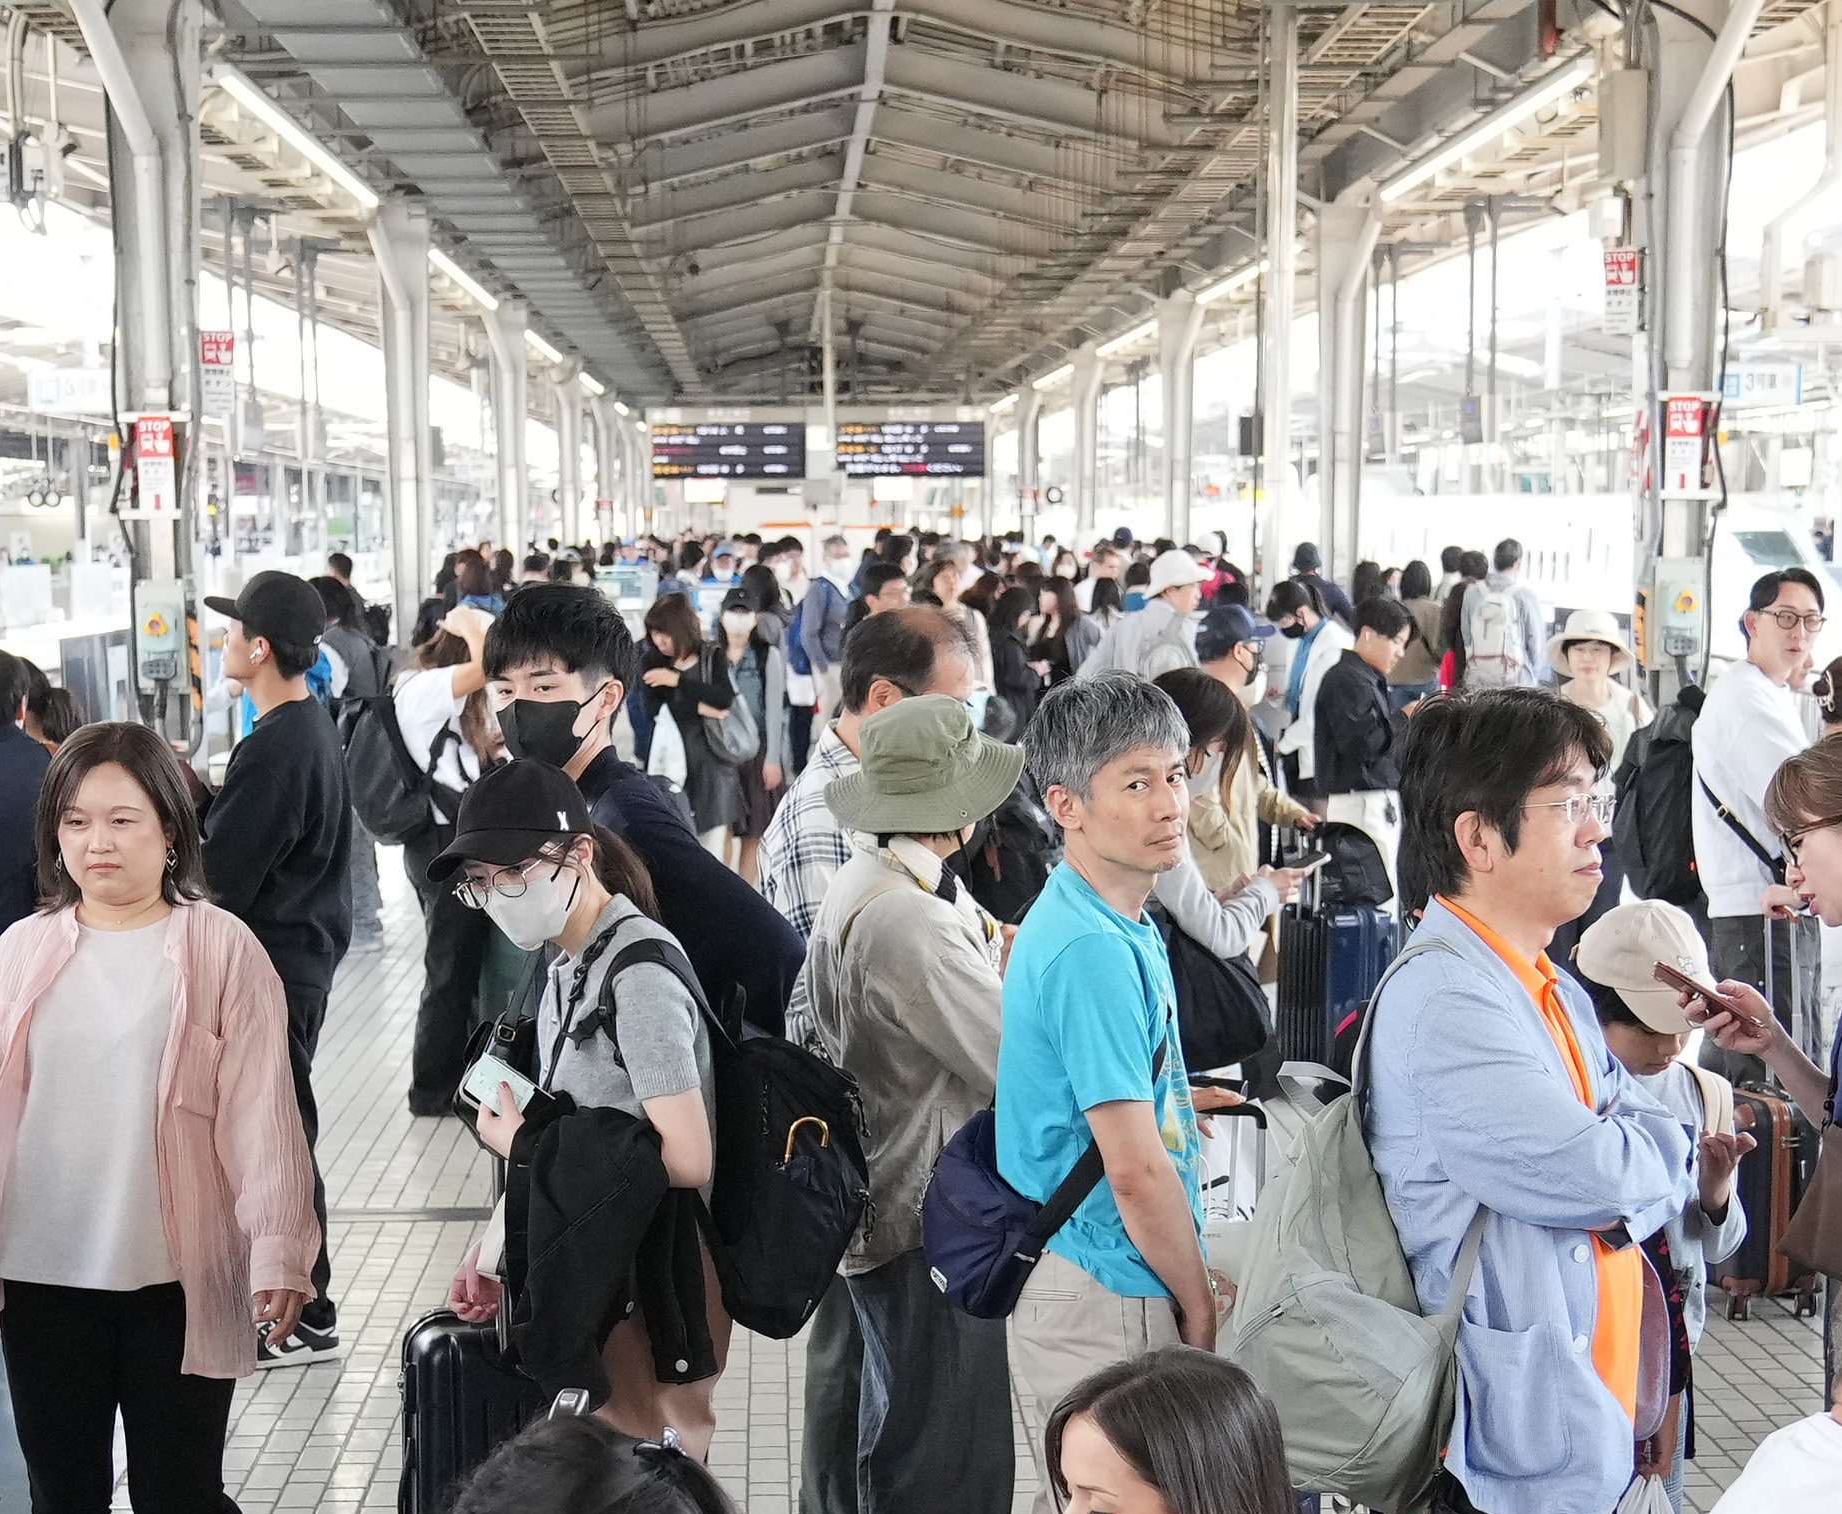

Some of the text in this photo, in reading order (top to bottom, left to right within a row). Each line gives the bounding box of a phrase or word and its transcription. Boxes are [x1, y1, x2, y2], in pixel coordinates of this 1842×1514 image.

[1604, 251, 1635, 264] STOP
[202, 332, 234, 343] STOP
[1669, 400, 1700, 412] STOP
[138, 420, 171, 432] STOP
